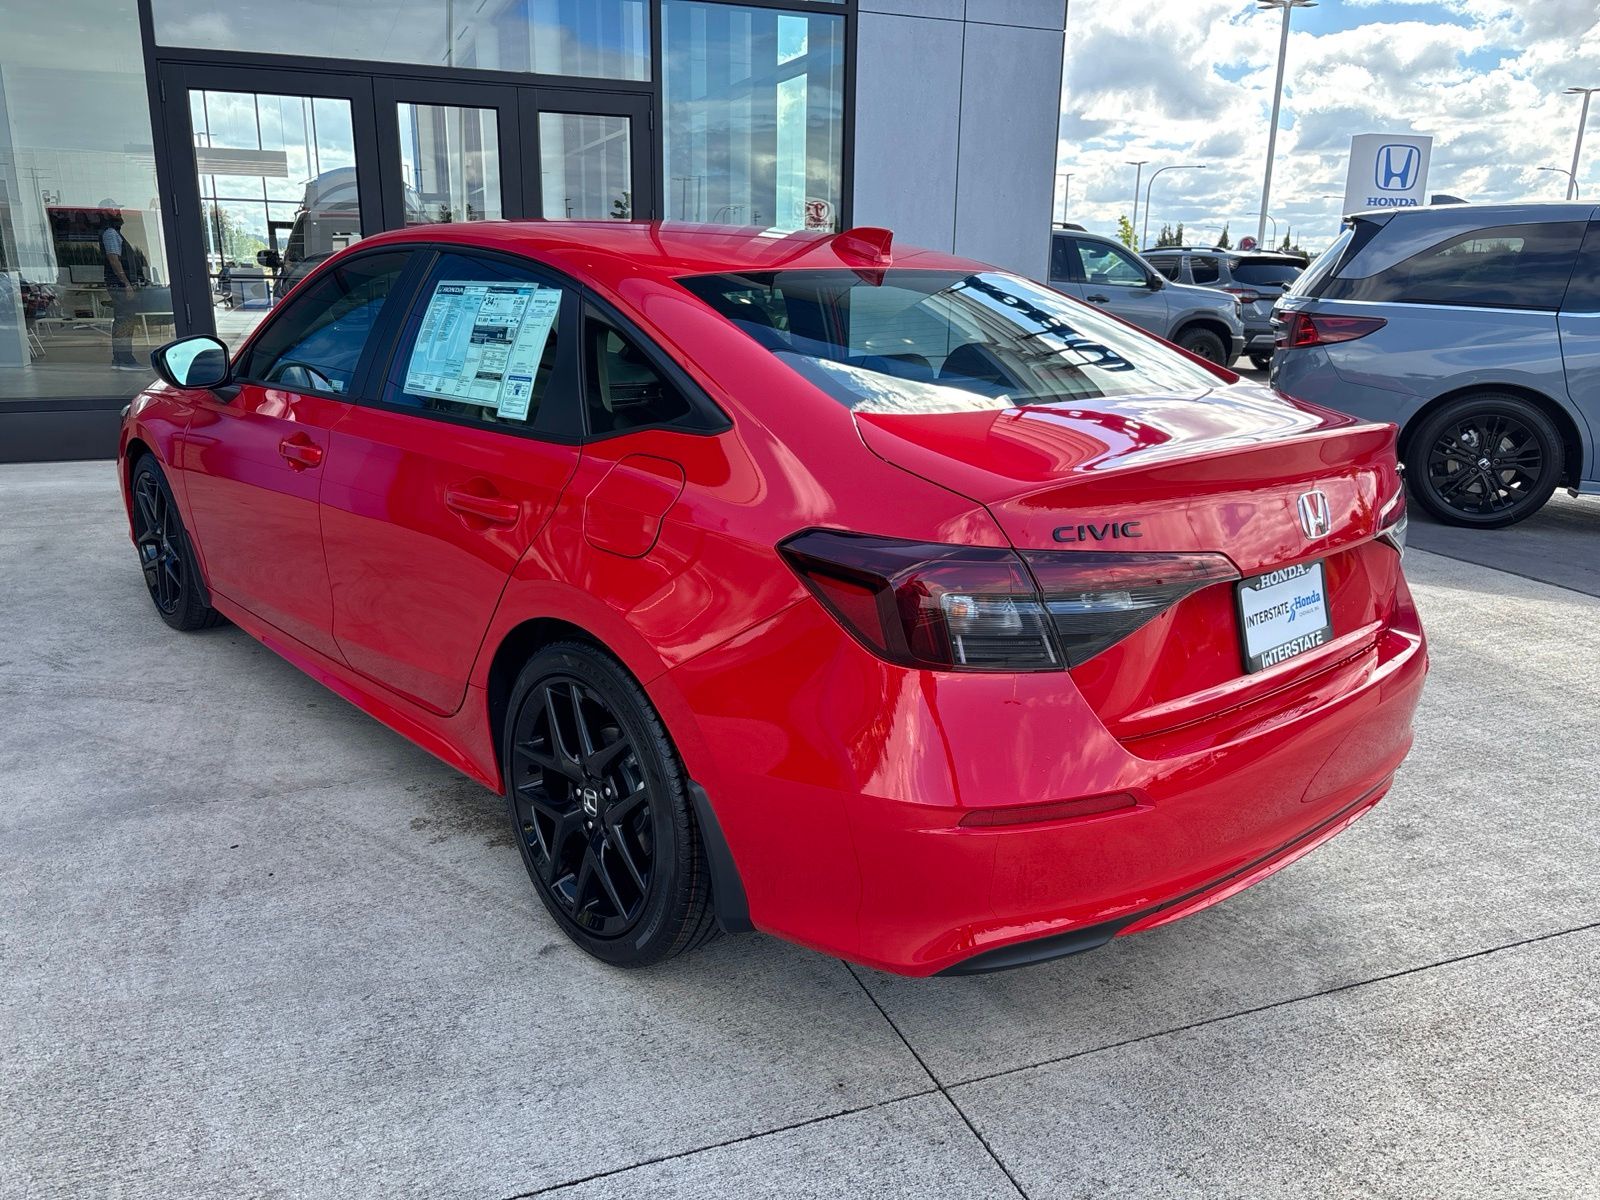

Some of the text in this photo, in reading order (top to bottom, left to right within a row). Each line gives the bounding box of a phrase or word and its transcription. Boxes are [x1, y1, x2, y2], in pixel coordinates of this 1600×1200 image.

[1366, 197, 1418, 207] HONDA
[442, 285, 464, 295] HONDA
[1052, 521, 1143, 543] CIVIC
[1260, 563, 1306, 589] HONDA
[1246, 601, 1290, 629] INTERSTATE
[1294, 590, 1321, 610] Honda
[1261, 630, 1324, 669] INTERSTATE
